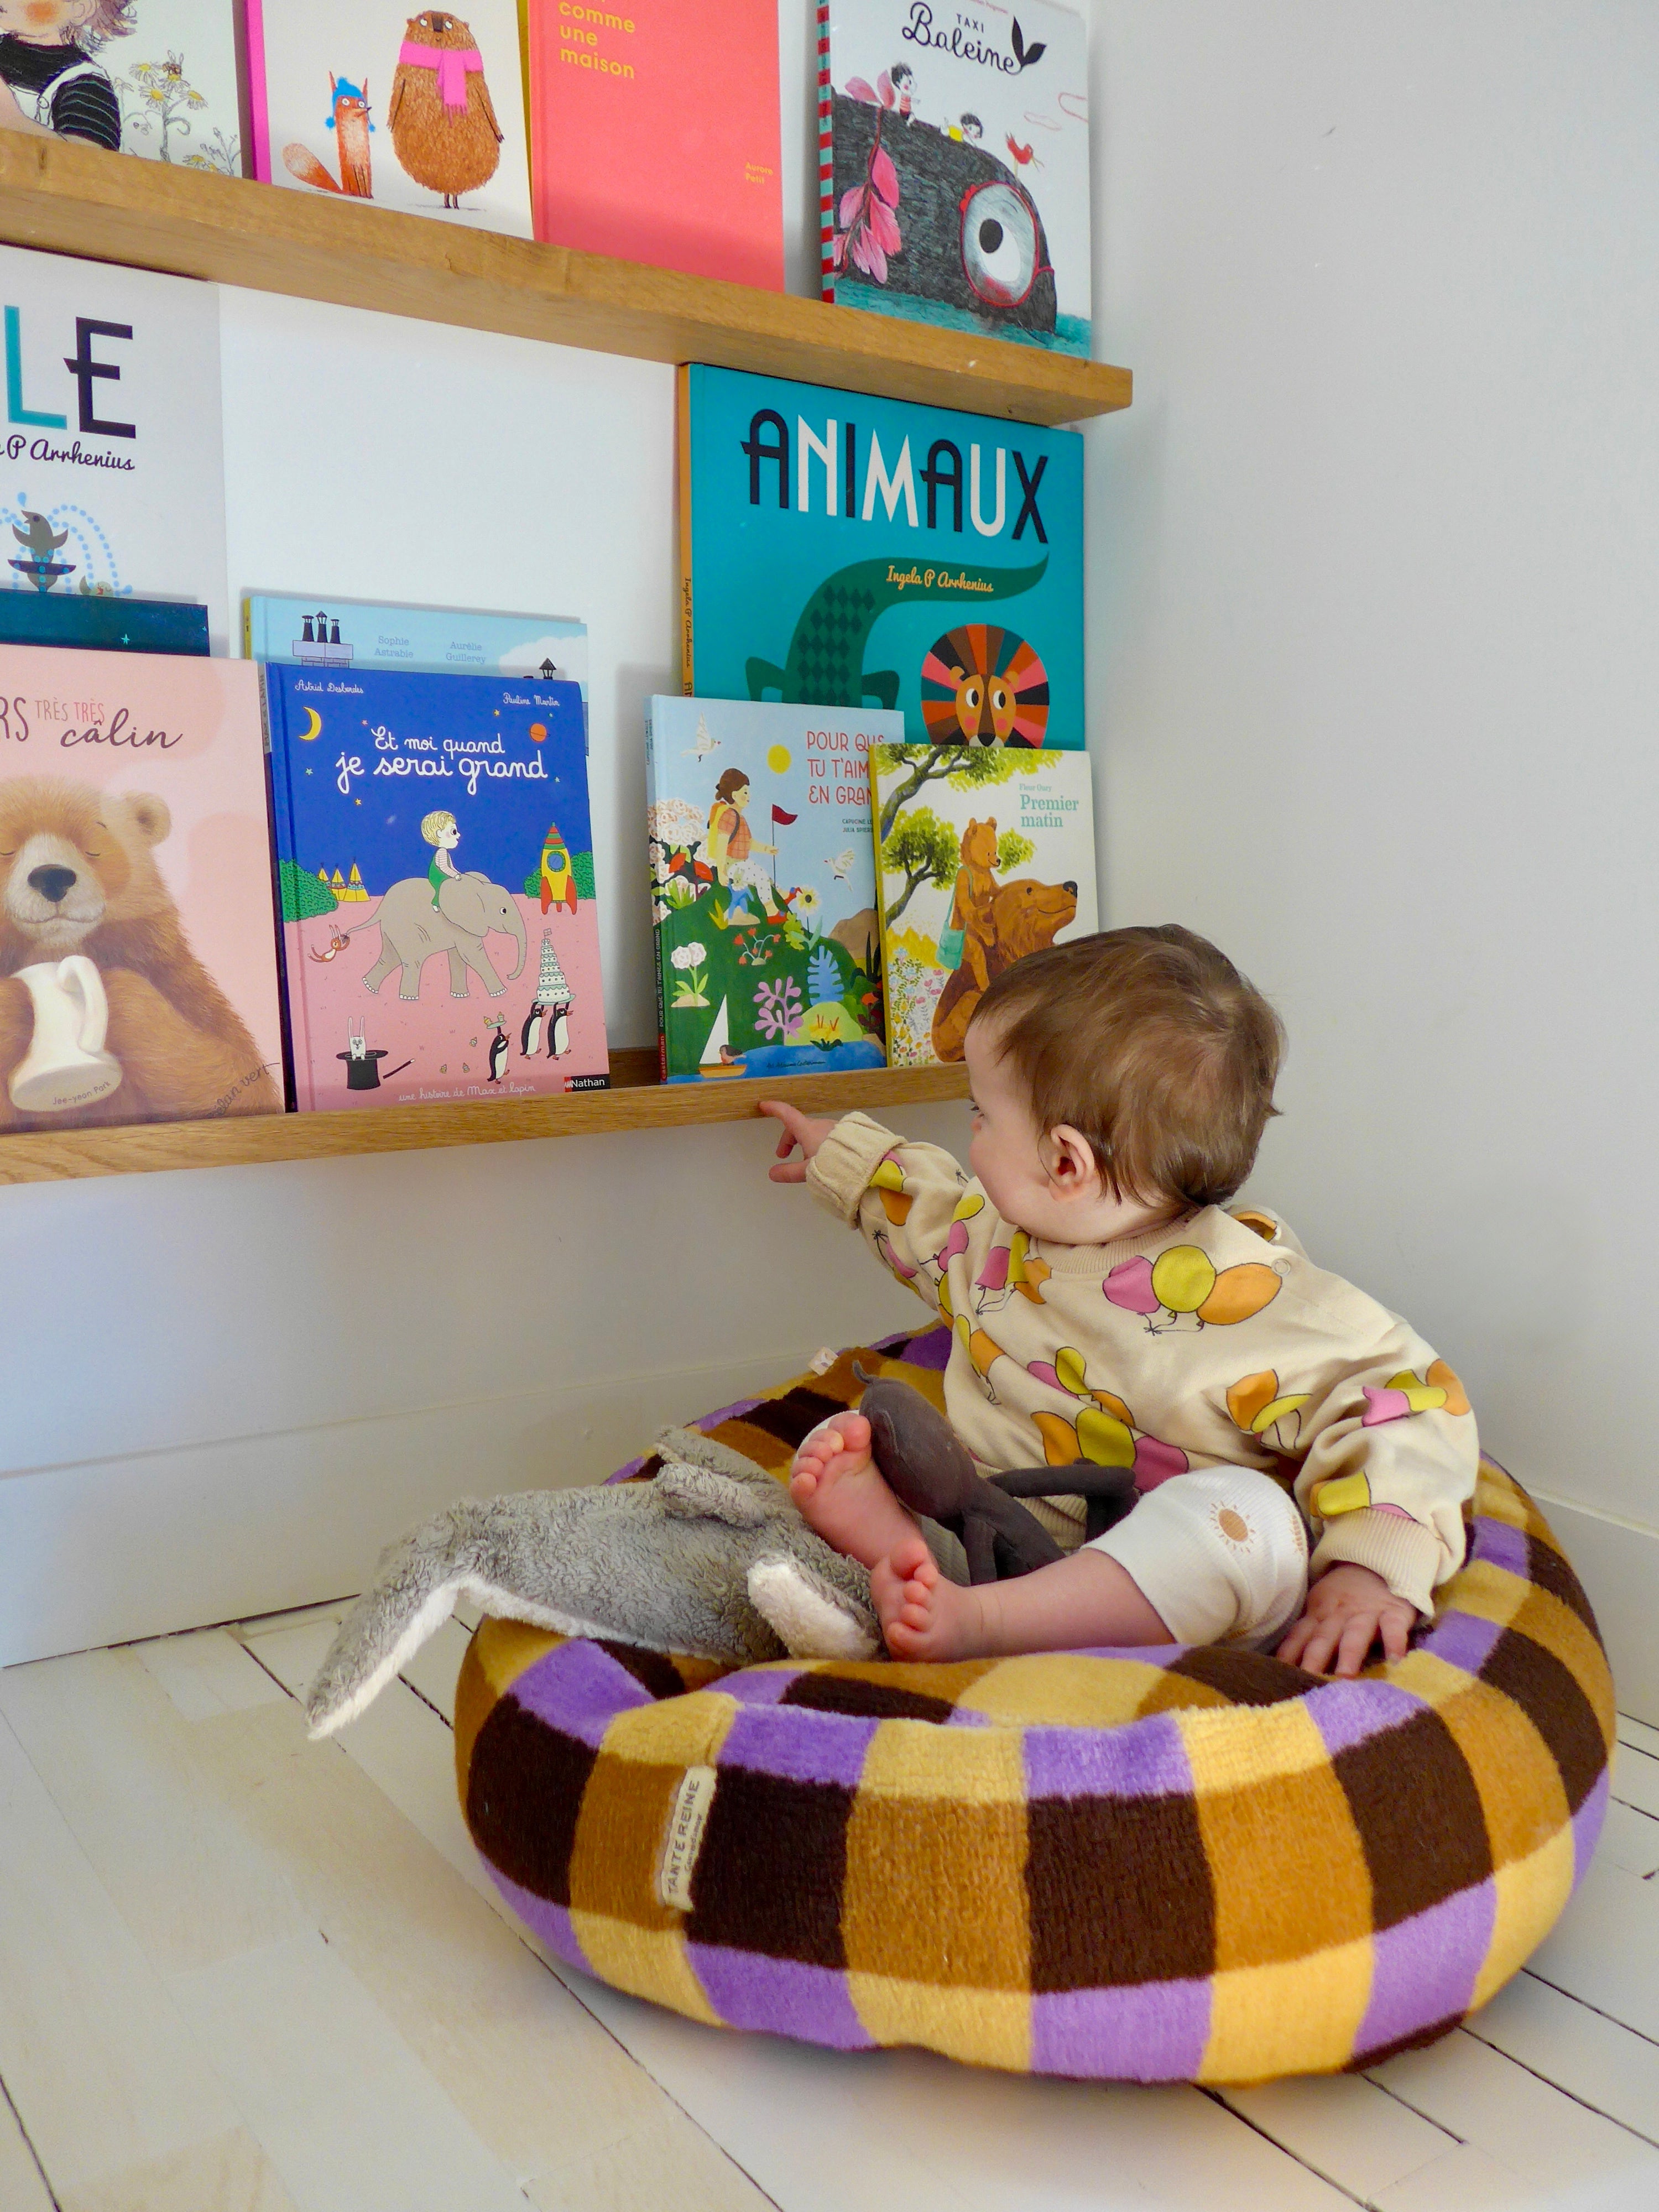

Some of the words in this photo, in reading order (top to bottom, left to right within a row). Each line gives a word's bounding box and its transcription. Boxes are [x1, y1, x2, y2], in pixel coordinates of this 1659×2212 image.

[558, 2, 636, 33] comme
[956, 13, 984, 33] TAXI
[560, 24, 597, 46] une
[902, 2, 1022, 75] Baleine
[560, 48, 634, 79] maison
[7, 434, 27, 460] P
[30, 439, 135, 471] Arrhenius
[740, 408, 1048, 545] ANIMAUX
[886, 565, 922, 591] Ingela
[924, 568, 936, 588] P
[937, 571, 994, 593] Arrhenius
[378, 635, 409, 646] Sophie
[450, 641, 483, 651] Aurélie
[374, 648, 414, 658] Astrabie
[295, 679, 324, 692] Astrid
[327, 682, 364, 694] Desbordes
[503, 692, 531, 705] Pauline
[534, 694, 560, 707] Martin
[34, 697, 68, 722] TRÈS
[74, 698, 105, 724] TRÈS
[60, 708, 183, 749] câlin
[370, 725, 398, 750] Et
[404, 736, 438, 751] moi
[442, 733, 505, 760] quand
[807, 731, 849, 752] POUR
[335, 752, 365, 794] je
[373, 755, 453, 776] serai
[458, 750, 548, 795] grand
[807, 759, 826, 777] TU
[808, 785, 830, 804] EN
[1019, 794, 1079, 811] Premier
[1020, 812, 1063, 828] matin
[239, 1062, 280, 1087] vert
[571, 1078, 606, 1088] Nathan
[93, 1081, 111, 1094] Park
[399, 1093, 416, 1102] une
[419, 1087, 451, 1099] histoire
[452, 1087, 465, 1097] de
[467, 1086, 497, 1095] Max
[498, 1085, 508, 1094] et
[509, 1082, 536, 1097] lapin
[667, 1840, 685, 1894] TANTE
[677, 1780, 700, 1836] REINE
